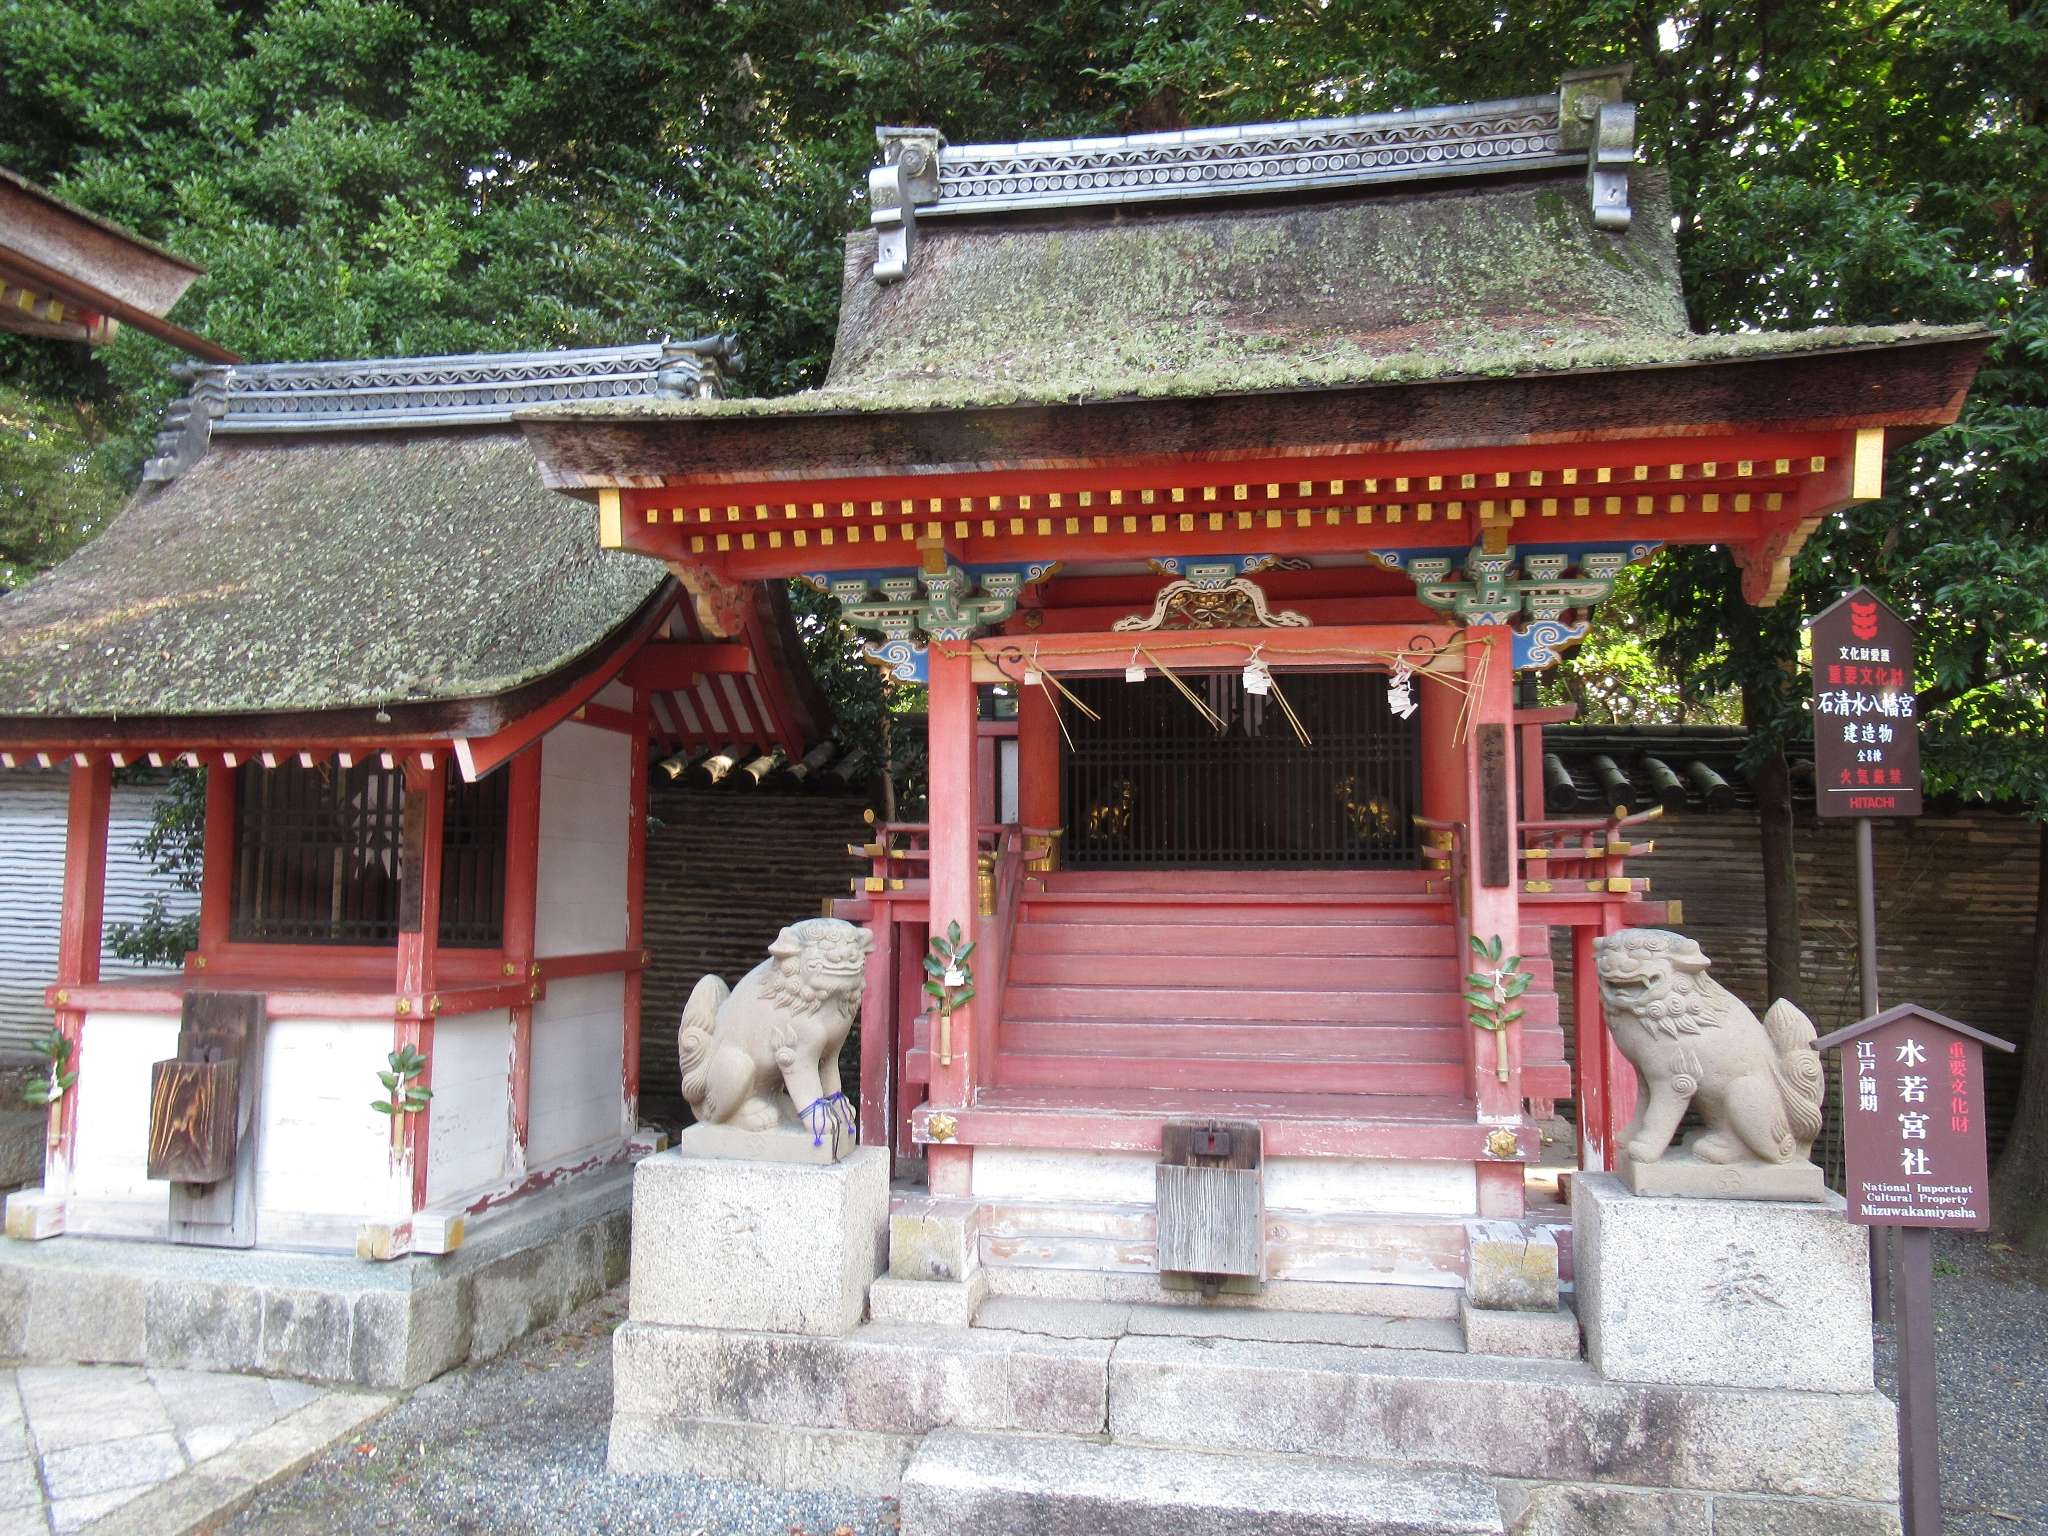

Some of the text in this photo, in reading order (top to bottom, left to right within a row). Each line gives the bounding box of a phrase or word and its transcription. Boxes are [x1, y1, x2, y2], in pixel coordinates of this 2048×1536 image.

[1828, 665, 1904, 686] 重要文化財
[1817, 690, 1915, 718] 石清水八幡宮
[1843, 722, 1893, 744] 建造物
[1850, 797, 1895, 809] HITACHI
[1856, 1041, 1878, 1113] 江戸前期
[1949, 1042, 1969, 1133] 重要文化財
[1896, 1039, 1933, 1176] 水若宮社
[1862, 1182, 1973, 1195] National Important
[1867, 1193, 1968, 1205] Cultural Property
[1861, 1204, 1976, 1219] Mizuwakamiyasha
